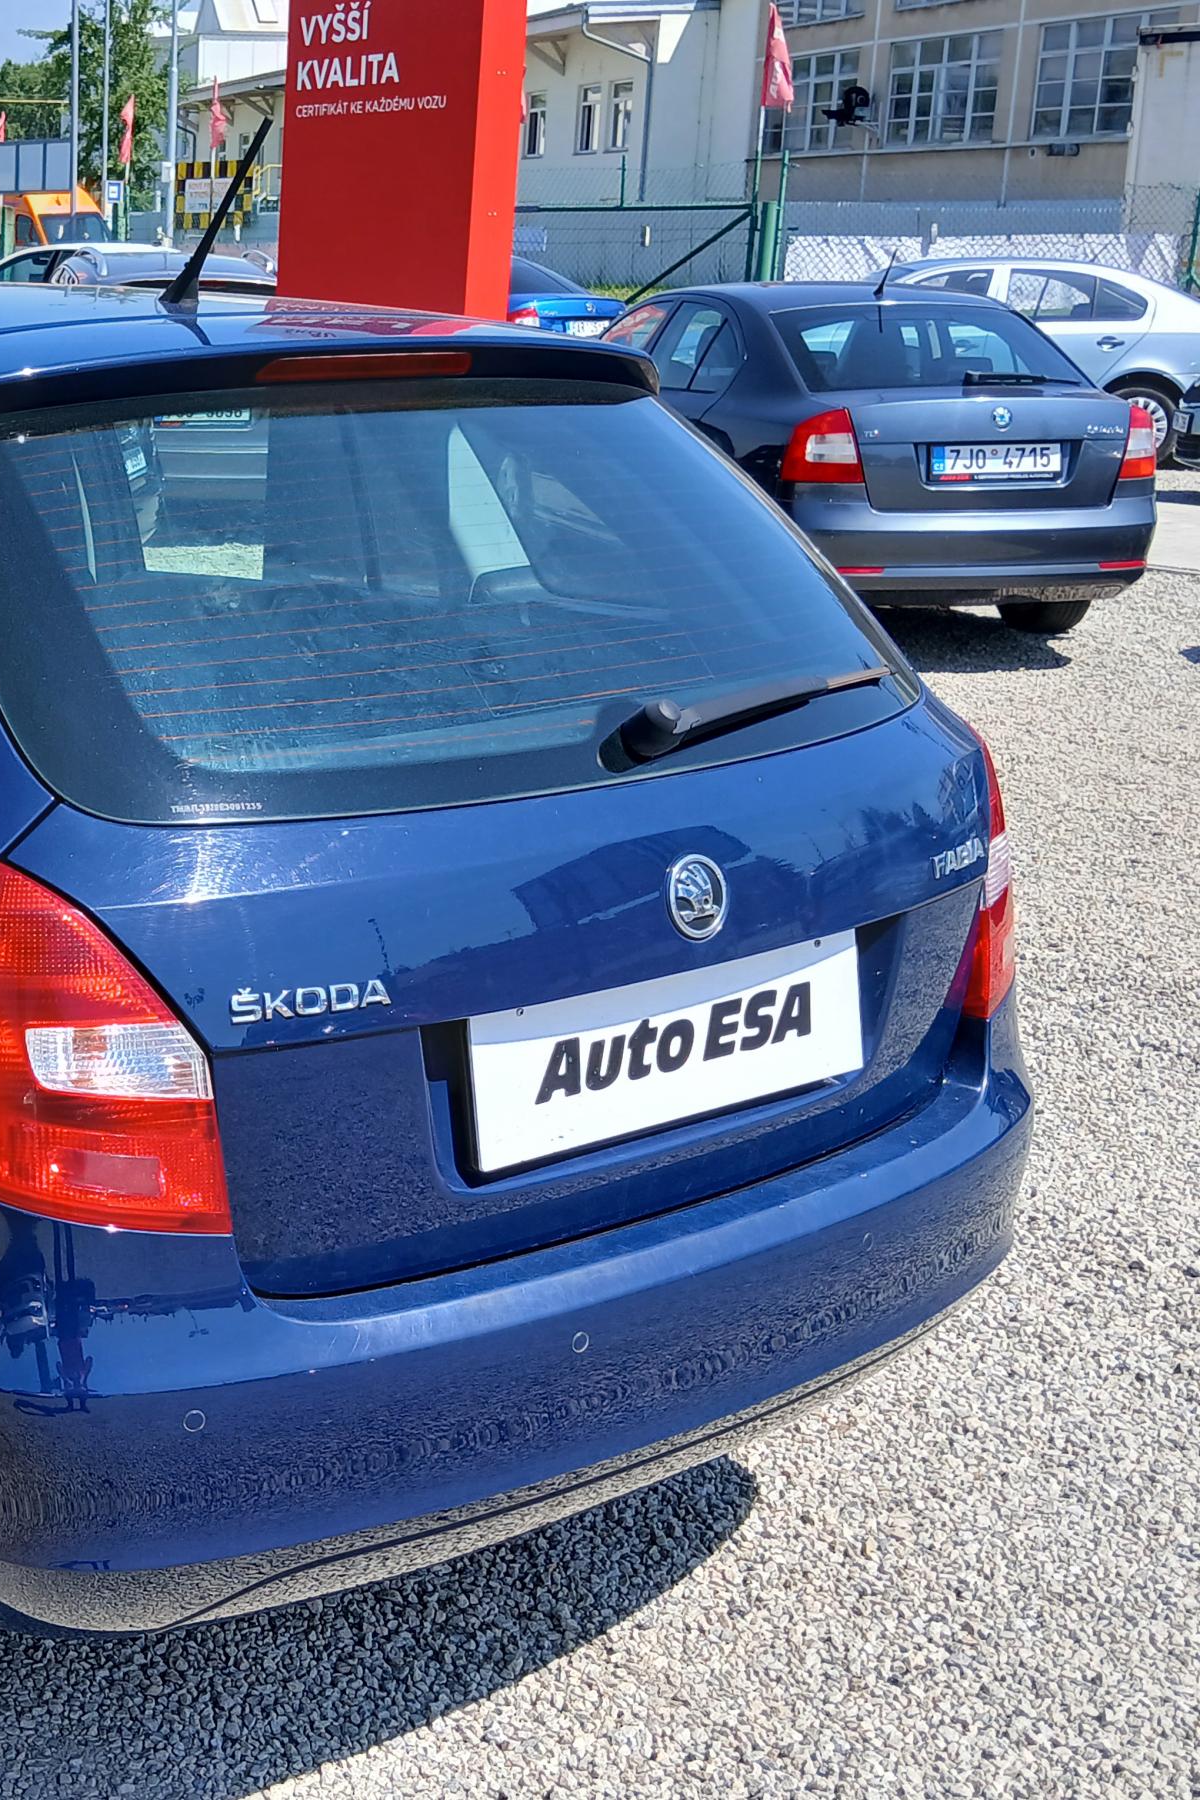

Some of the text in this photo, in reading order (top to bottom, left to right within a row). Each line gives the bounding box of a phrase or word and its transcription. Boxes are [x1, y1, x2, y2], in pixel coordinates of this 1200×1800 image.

[300, 1, 371, 47] VYŠŠÍ
[296, 52, 400, 91] KVALITA
[296, 95, 447, 118] CERTIFIKÁT KE KAŽDÉMU VOZU
[949, 447, 987, 470] 7J0
[1002, 446, 1051, 469] 4715
[930, 836, 985, 879] FABIA
[231, 979, 392, 1024] ŠKODA
[534, 981, 812, 1106] Auto ESA
